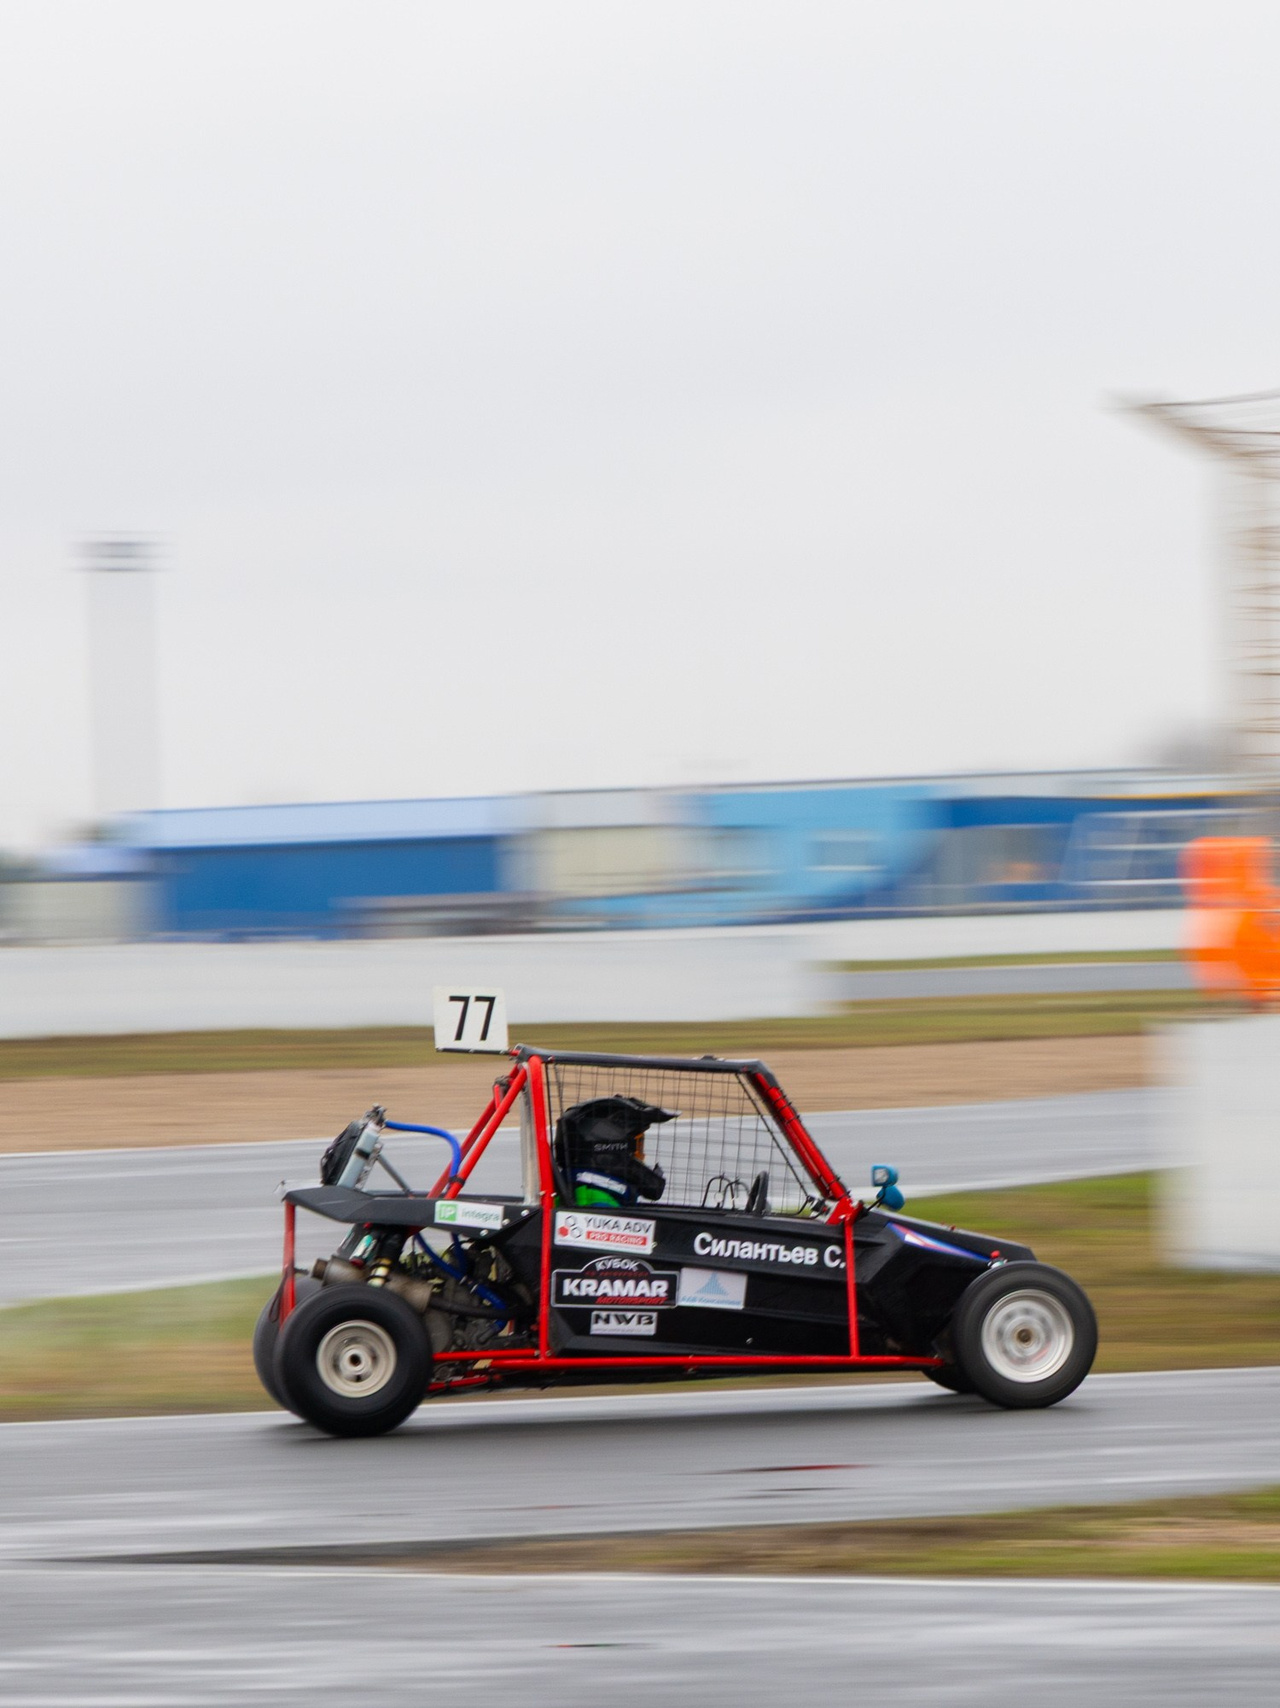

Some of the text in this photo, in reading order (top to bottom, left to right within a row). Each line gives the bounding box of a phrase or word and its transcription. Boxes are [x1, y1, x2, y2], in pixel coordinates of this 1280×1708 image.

[448, 995, 497, 1041] 77
[594, 1143, 629, 1152] SMITH
[585, 1216, 652, 1234] YUKA ADV
[589, 1231, 608, 1242] PRO
[609, 1234, 644, 1245] RACING
[693, 1231, 847, 1269] Силантьев С.
[595, 1258, 639, 1272] КУБОК
[562, 1278, 669, 1297] KRAMAR
[595, 1296, 668, 1305] MOTORSPORT
[594, 1313, 655, 1326] NWB
